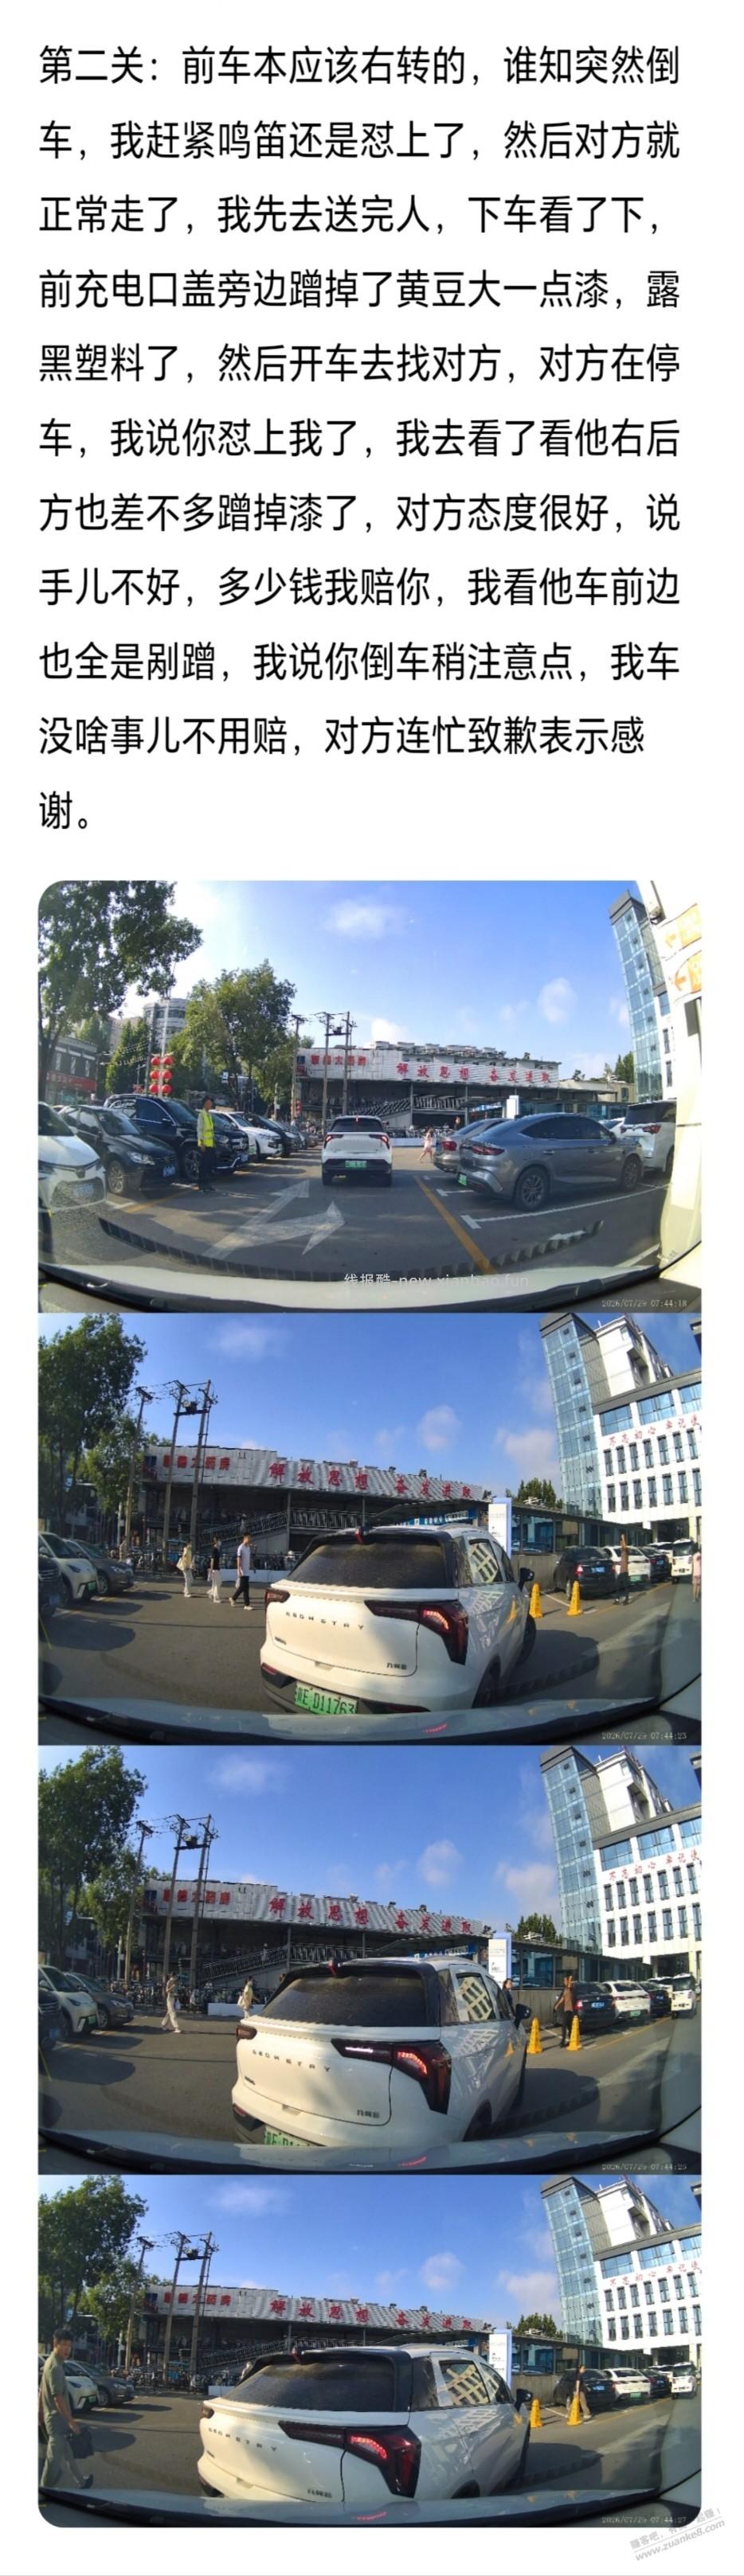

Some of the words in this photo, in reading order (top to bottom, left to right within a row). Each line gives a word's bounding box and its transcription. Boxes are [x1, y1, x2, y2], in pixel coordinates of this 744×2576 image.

[269, 1462, 369, 1490] 解放思想
[268, 1896, 369, 1925] 解放思想
[269, 2297, 370, 2323] 解放思想
